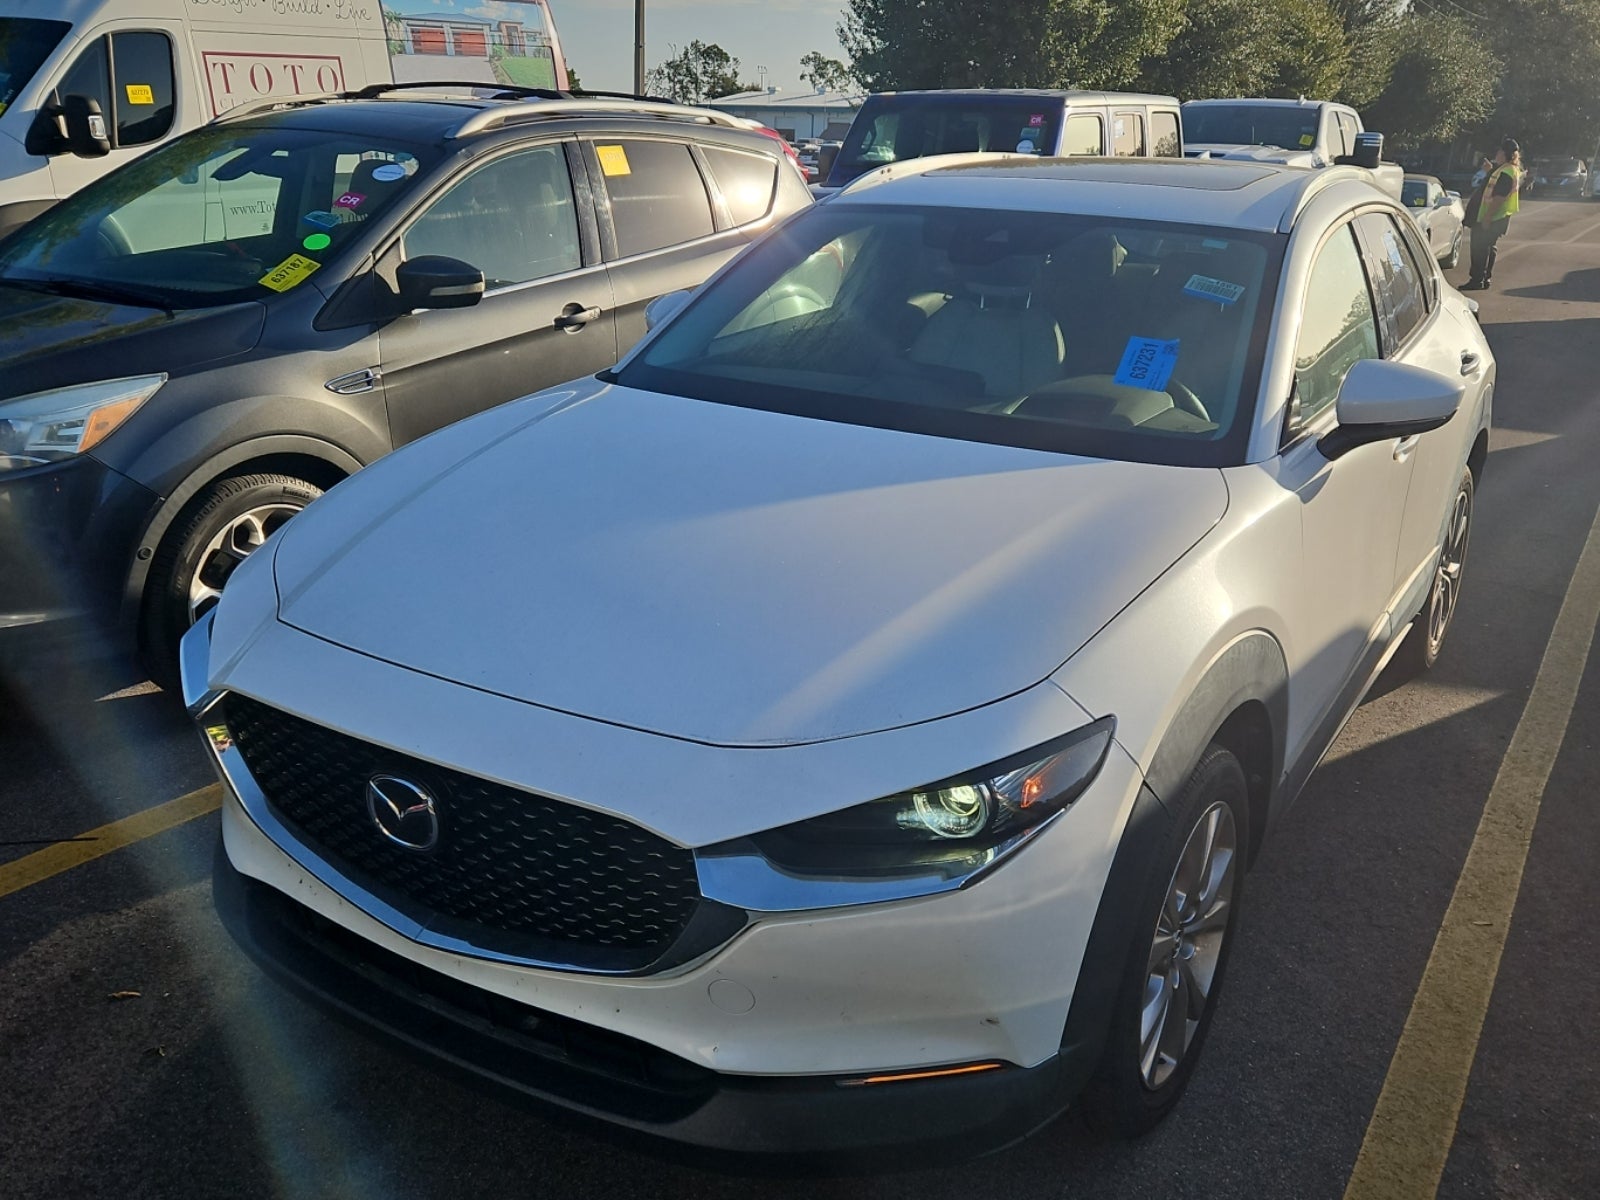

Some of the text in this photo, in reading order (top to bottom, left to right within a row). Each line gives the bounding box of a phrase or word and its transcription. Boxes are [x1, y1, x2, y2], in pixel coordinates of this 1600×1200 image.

[212, 62, 339, 96] TOTO
[340, 195, 360, 206] CR
[270, 257, 304, 284] 637187
[1129, 343, 1159, 380] 637231
